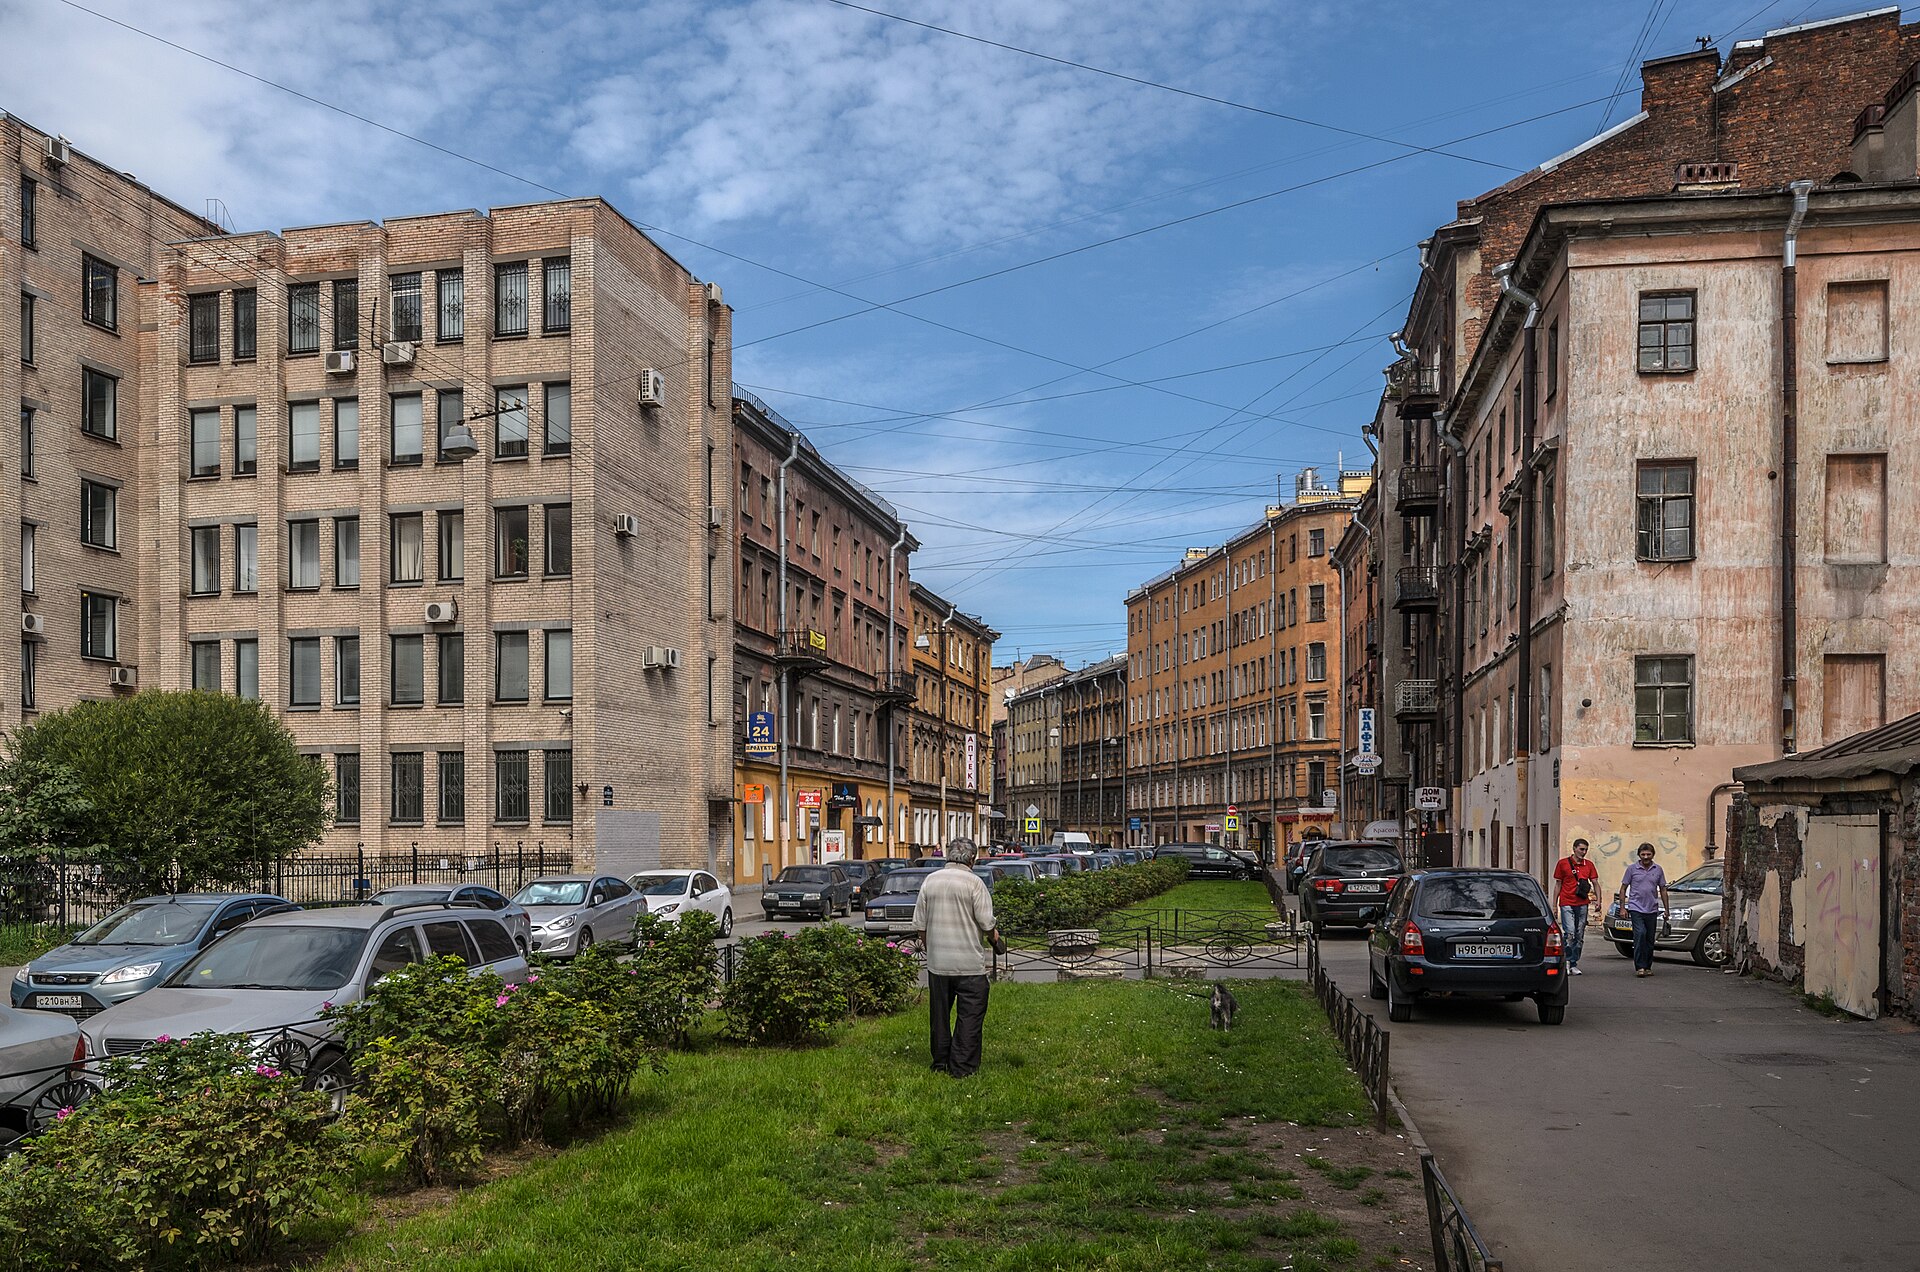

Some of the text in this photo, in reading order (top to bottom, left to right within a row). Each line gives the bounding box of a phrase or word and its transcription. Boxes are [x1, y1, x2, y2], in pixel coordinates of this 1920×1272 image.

[752, 726, 770, 737] 24
[1361, 710, 1372, 752] КАФЕ
[1421, 788, 1440, 796] ДОМ
[1458, 945, 1511, 955] Н981РО 178
[39, 996, 70, 1006] С210ВН
